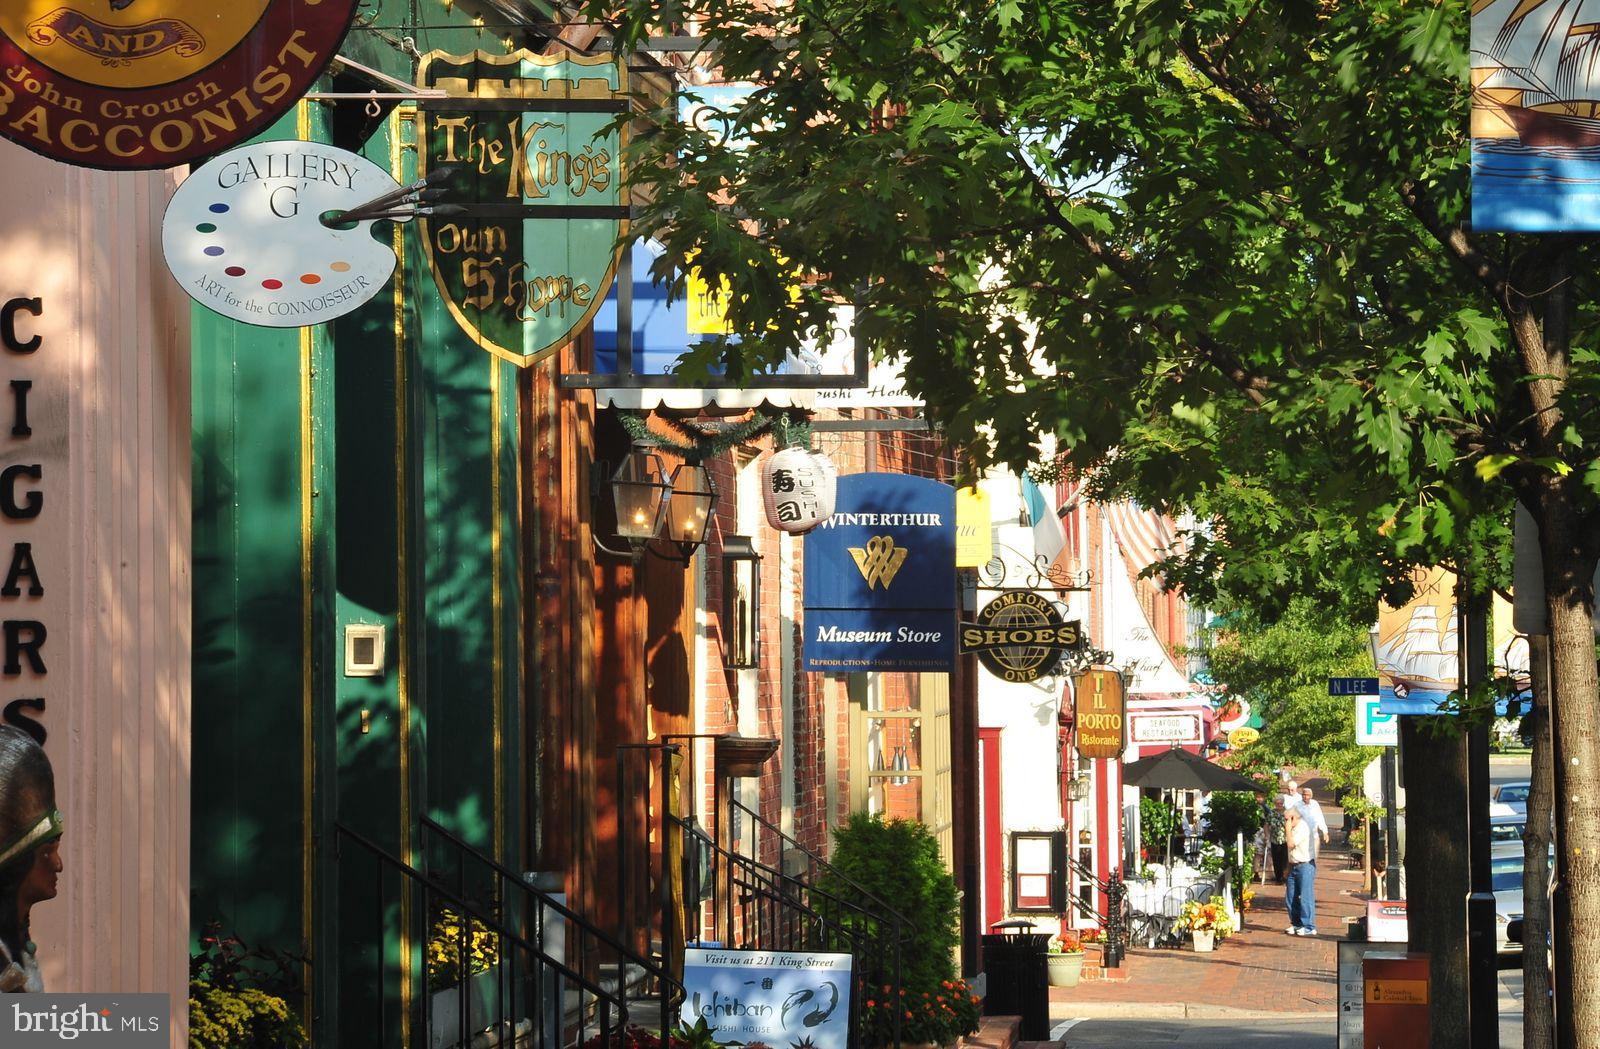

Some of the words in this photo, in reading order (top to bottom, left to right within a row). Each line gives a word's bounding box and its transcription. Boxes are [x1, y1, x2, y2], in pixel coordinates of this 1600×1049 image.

[67, 25, 165, 53] AND
[6, 66, 83, 113] John
[100, 80, 222, 119] Crouch
[433, 115, 505, 174] The
[218, 153, 360, 191] GALLERY
[195, 274, 226, 299] ART
[224, 291, 242, 308] for
[245, 296, 263, 314] the
[268, 275, 370, 316] CONNOISSEUR
[462, 257, 591, 322] Shoppe
[0, 297, 48, 748] CIGARS
[821, 513, 942, 530] WINTERTHUR
[984, 592, 1056, 618] COMFORT
[816, 626, 892, 643] Museum
[897, 626, 941, 643] Store
[963, 626, 1077, 648] SHOES
[1004, 668, 1038, 682] ONE
[1333, 680, 1341, 694] N
[1346, 680, 1367, 694] LEE
[1093, 693, 1107, 709] IL
[1077, 713, 1122, 731] PORTO
[1150, 719, 1180, 728] SEAFOOD
[1081, 733, 1120, 746] Ristorante
[1142, 728, 1187, 737] RESTAURANT
[704, 954, 727, 964] Visit
[757, 956, 775, 965] 211
[779, 957, 803, 968] King
[805, 957, 834, 967] Street
[692, 990, 773, 1018] Ichiban
[742, 1025, 773, 1033] HOUSE
